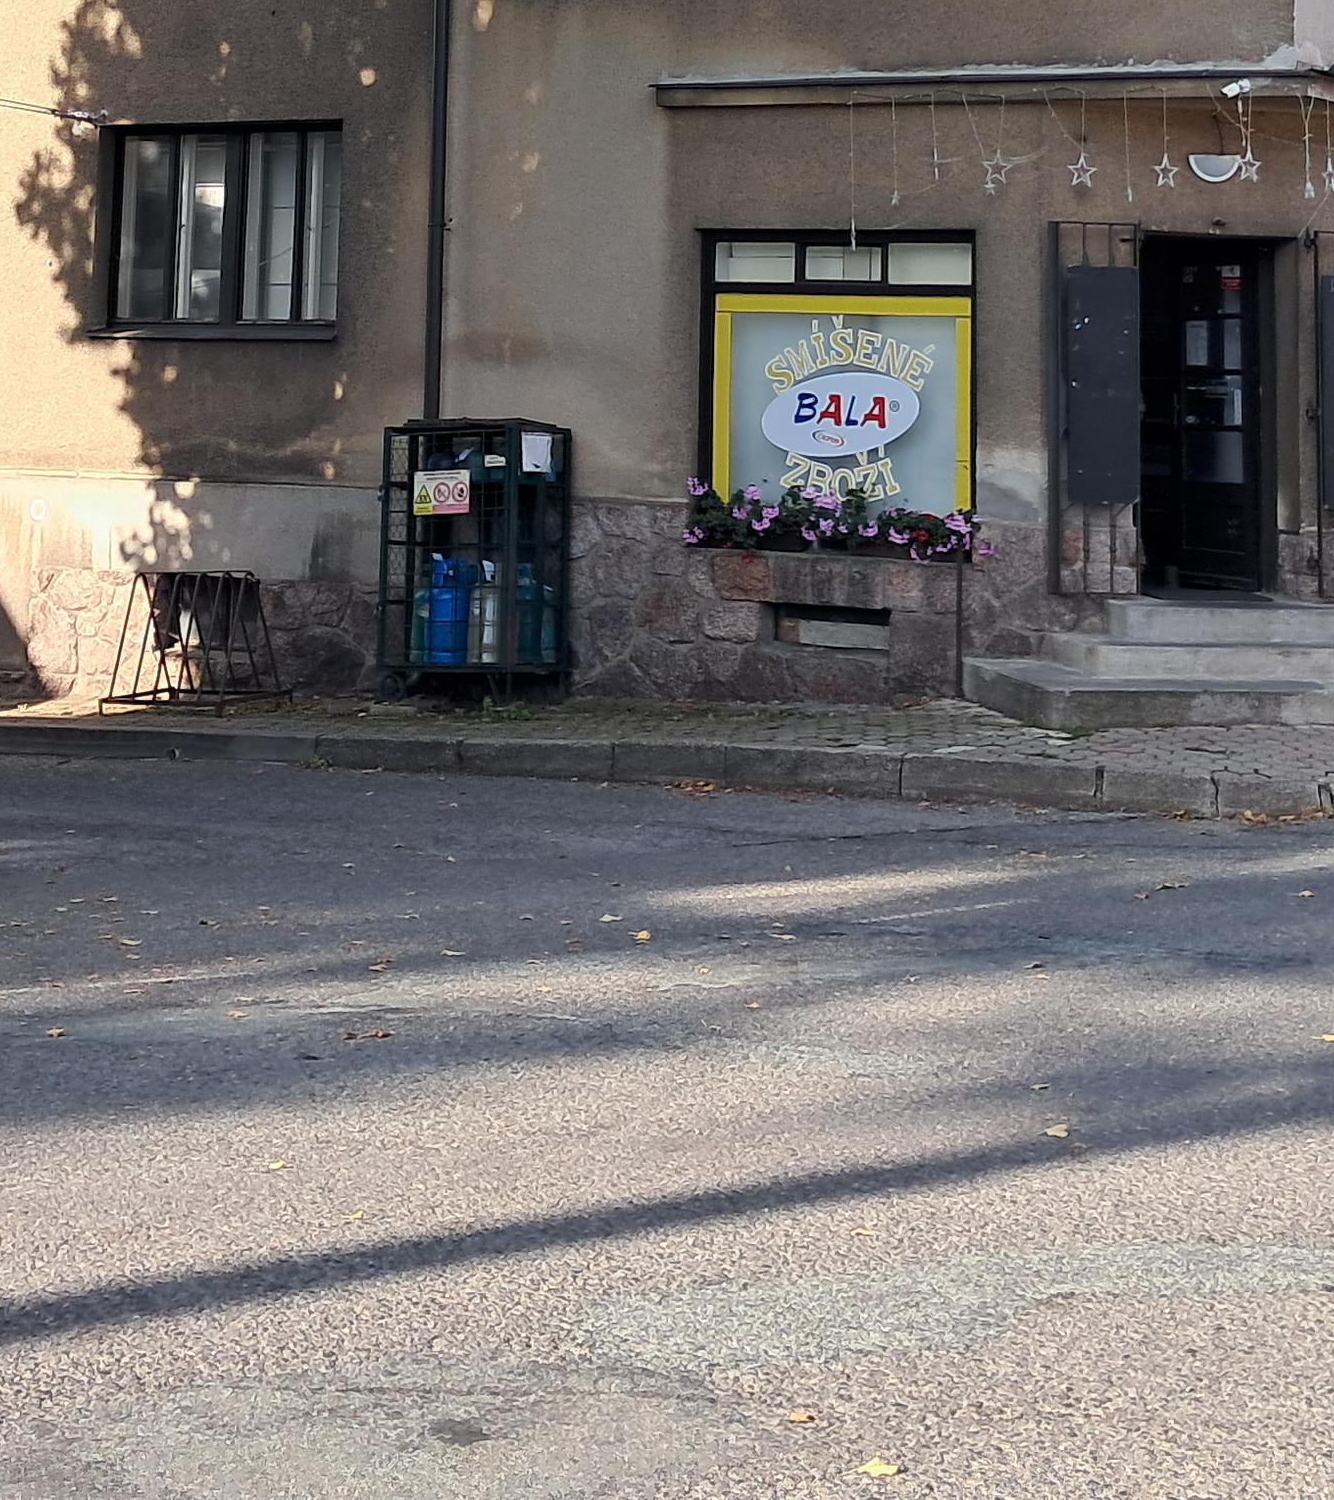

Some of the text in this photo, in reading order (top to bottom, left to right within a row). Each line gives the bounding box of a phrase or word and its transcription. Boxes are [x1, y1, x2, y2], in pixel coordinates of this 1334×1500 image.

[765, 315, 935, 395] SMÍŠENÉ
[794, 393, 886, 429] BALA
[780, 444, 901, 504] ZBOŽÍ
